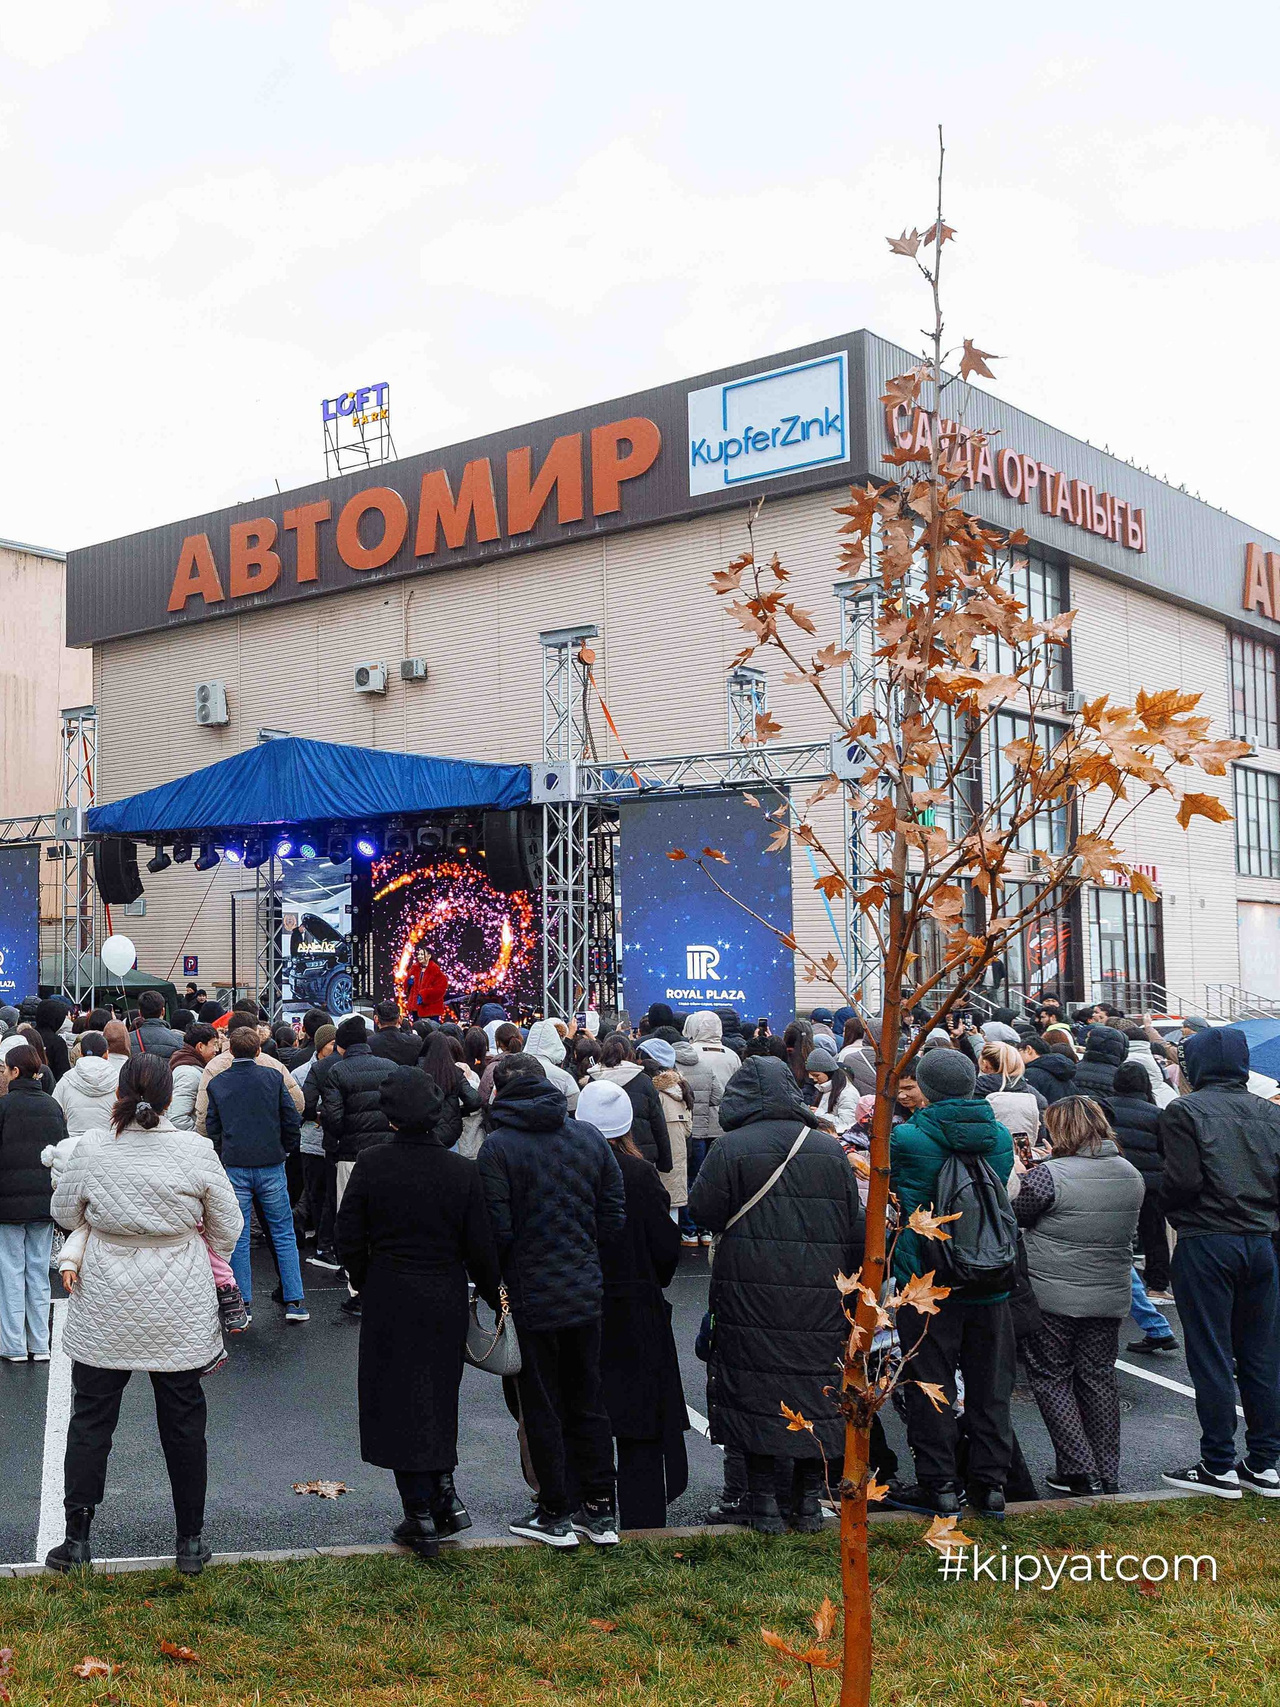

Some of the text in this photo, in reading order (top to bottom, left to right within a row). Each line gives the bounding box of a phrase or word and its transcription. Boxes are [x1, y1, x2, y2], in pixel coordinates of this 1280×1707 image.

[322, 381, 389, 421] LOFT
[352, 409, 388, 427] PARK
[691, 406, 841, 467] KupferZink
[167, 416, 660, 611] АВТОМИР
[996, 447, 1147, 554] ОРТАЛЫҒЫ
[666, 989, 746, 1000] ROYAL PLAZA
